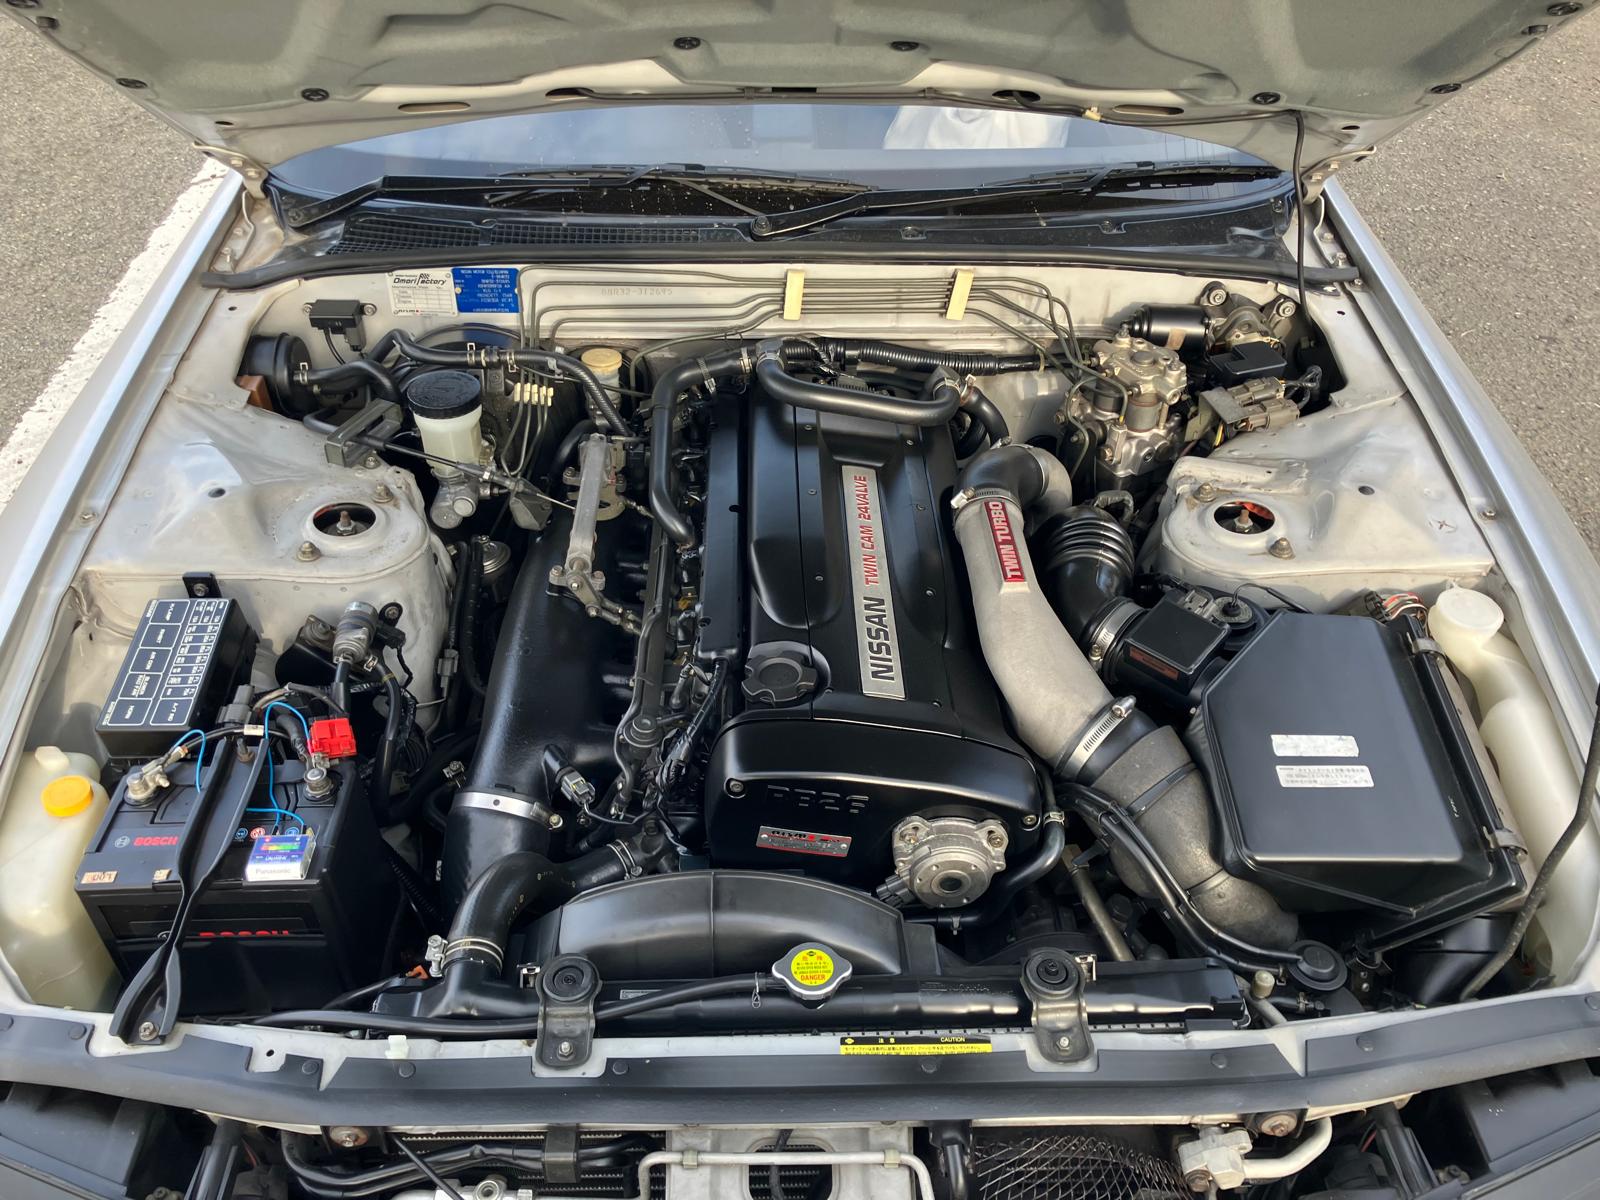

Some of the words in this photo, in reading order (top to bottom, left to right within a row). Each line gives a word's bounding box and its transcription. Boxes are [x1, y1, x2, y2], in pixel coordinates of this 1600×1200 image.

[853, 475, 871, 520] 24VALVE
[860, 526, 873, 550] CAM
[988, 501, 1011, 542] TURBO
[863, 554, 880, 586] TWIN
[1000, 544, 1022, 578] TWIN
[864, 597, 895, 682] NISSAN
[133, 836, 179, 847] BOSCH
